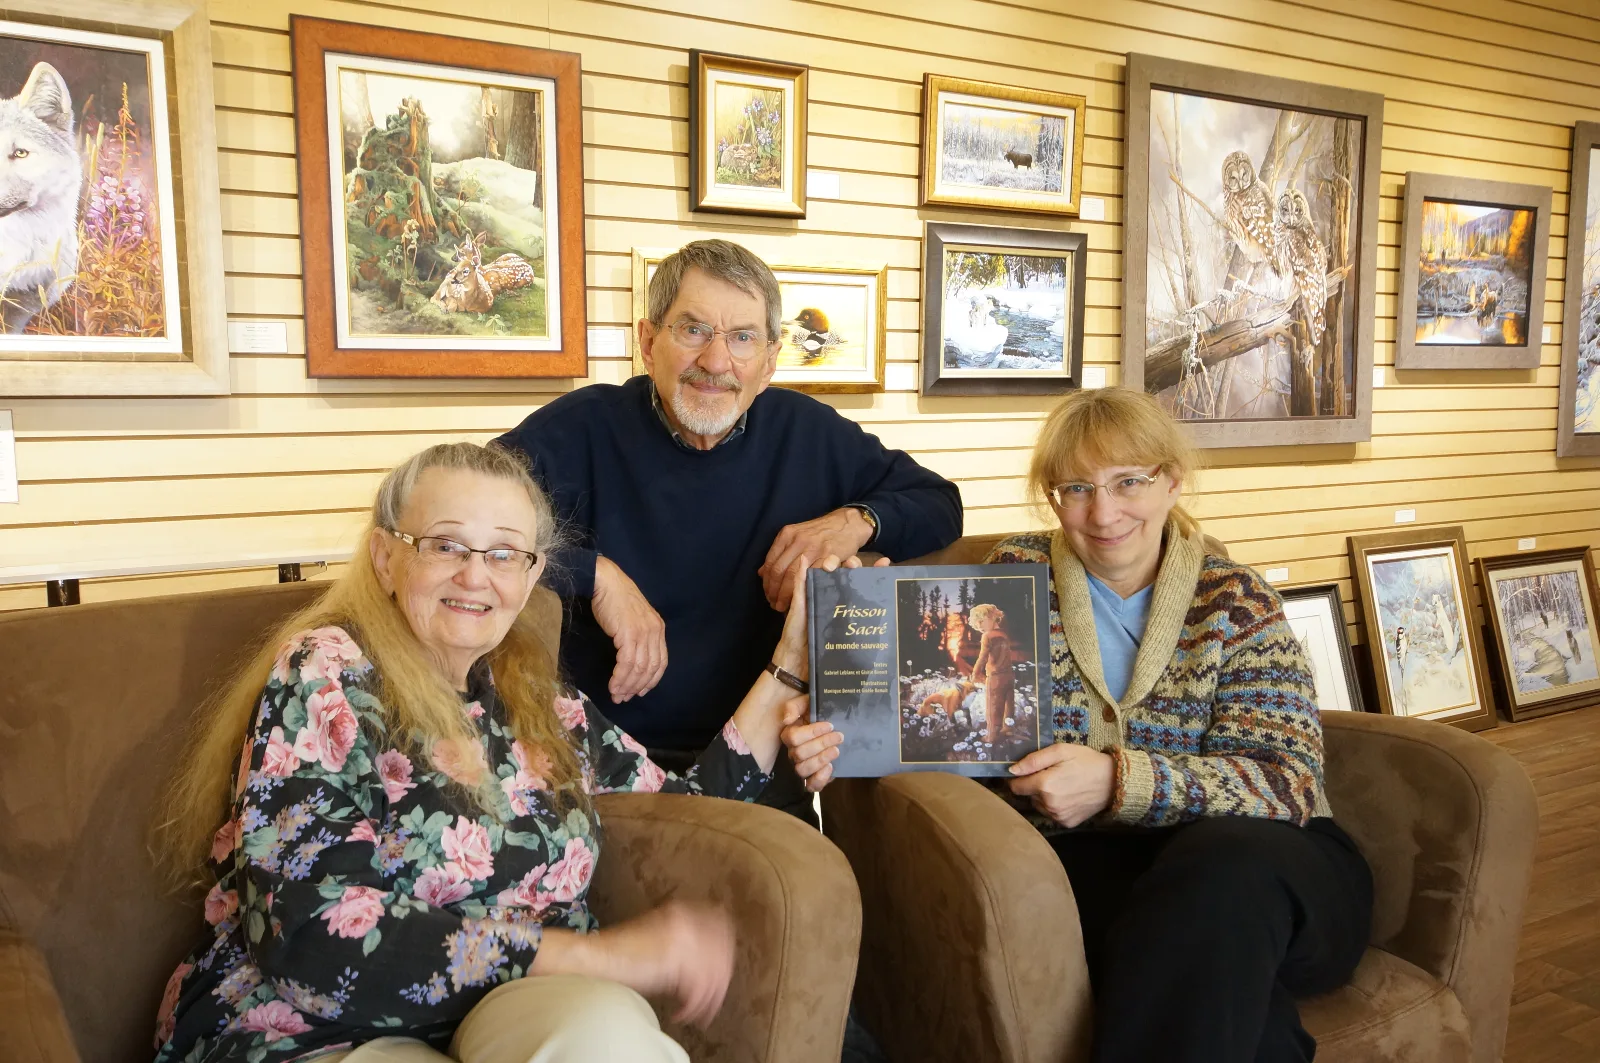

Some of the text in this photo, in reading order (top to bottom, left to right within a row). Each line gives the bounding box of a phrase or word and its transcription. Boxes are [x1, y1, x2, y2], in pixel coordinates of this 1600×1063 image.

[833, 604, 886, 618] Frisson
[846, 622, 888, 636] Sacré
[825, 642, 888, 650] du monde sauvage
